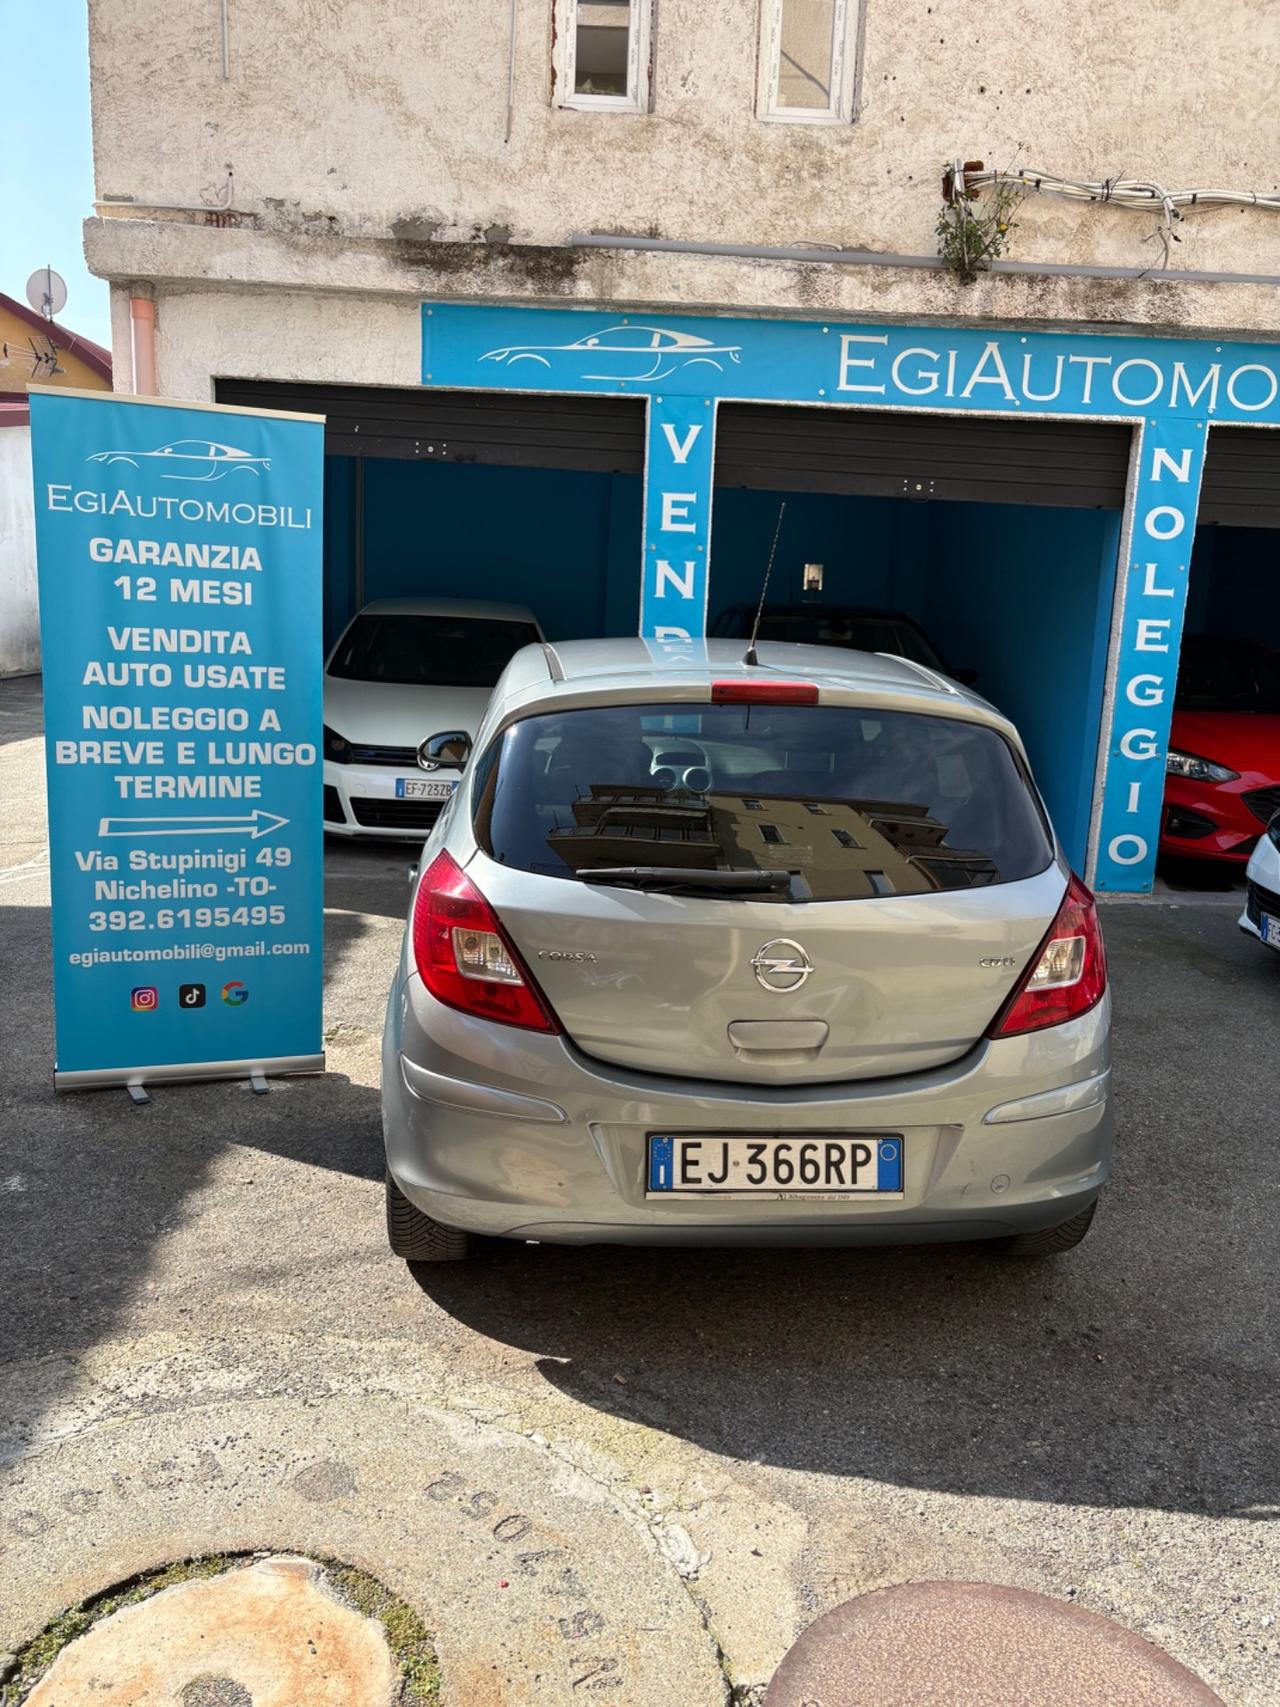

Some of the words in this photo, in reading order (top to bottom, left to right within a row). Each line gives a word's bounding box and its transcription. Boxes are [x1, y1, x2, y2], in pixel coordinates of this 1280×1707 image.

[89, 537, 263, 571] GARANZIA
[114, 576, 157, 601] 12
[170, 578, 252, 606] MESI
[107, 626, 252, 655] VENDITA
[1108, 447, 1194, 866] NOLEGGIO
[82, 661, 172, 687] AUTO
[184, 665, 286, 691] USATE
[82, 706, 249, 732] NOLEGGIO
[259, 708, 282, 732] A
[56, 741, 164, 766] BREVE
[177, 742, 196, 765] E
[208, 742, 317, 766] LUNGO
[114, 775, 262, 799] TERMINE
[74, 850, 118, 872] Via
[129, 847, 247, 874] Stupinigi
[256, 847, 292, 868] 49
[95, 877, 218, 901] Nichelino
[226, 876, 277, 897] -TO-
[89, 905, 286, 932] 392.6195495
[69, 941, 310, 968] egiautomobili@gmail.com
[538, 951, 598, 963] CORSA
[659, 1165, 665, 1185] I
[746, 1142, 872, 1185] 366RP
